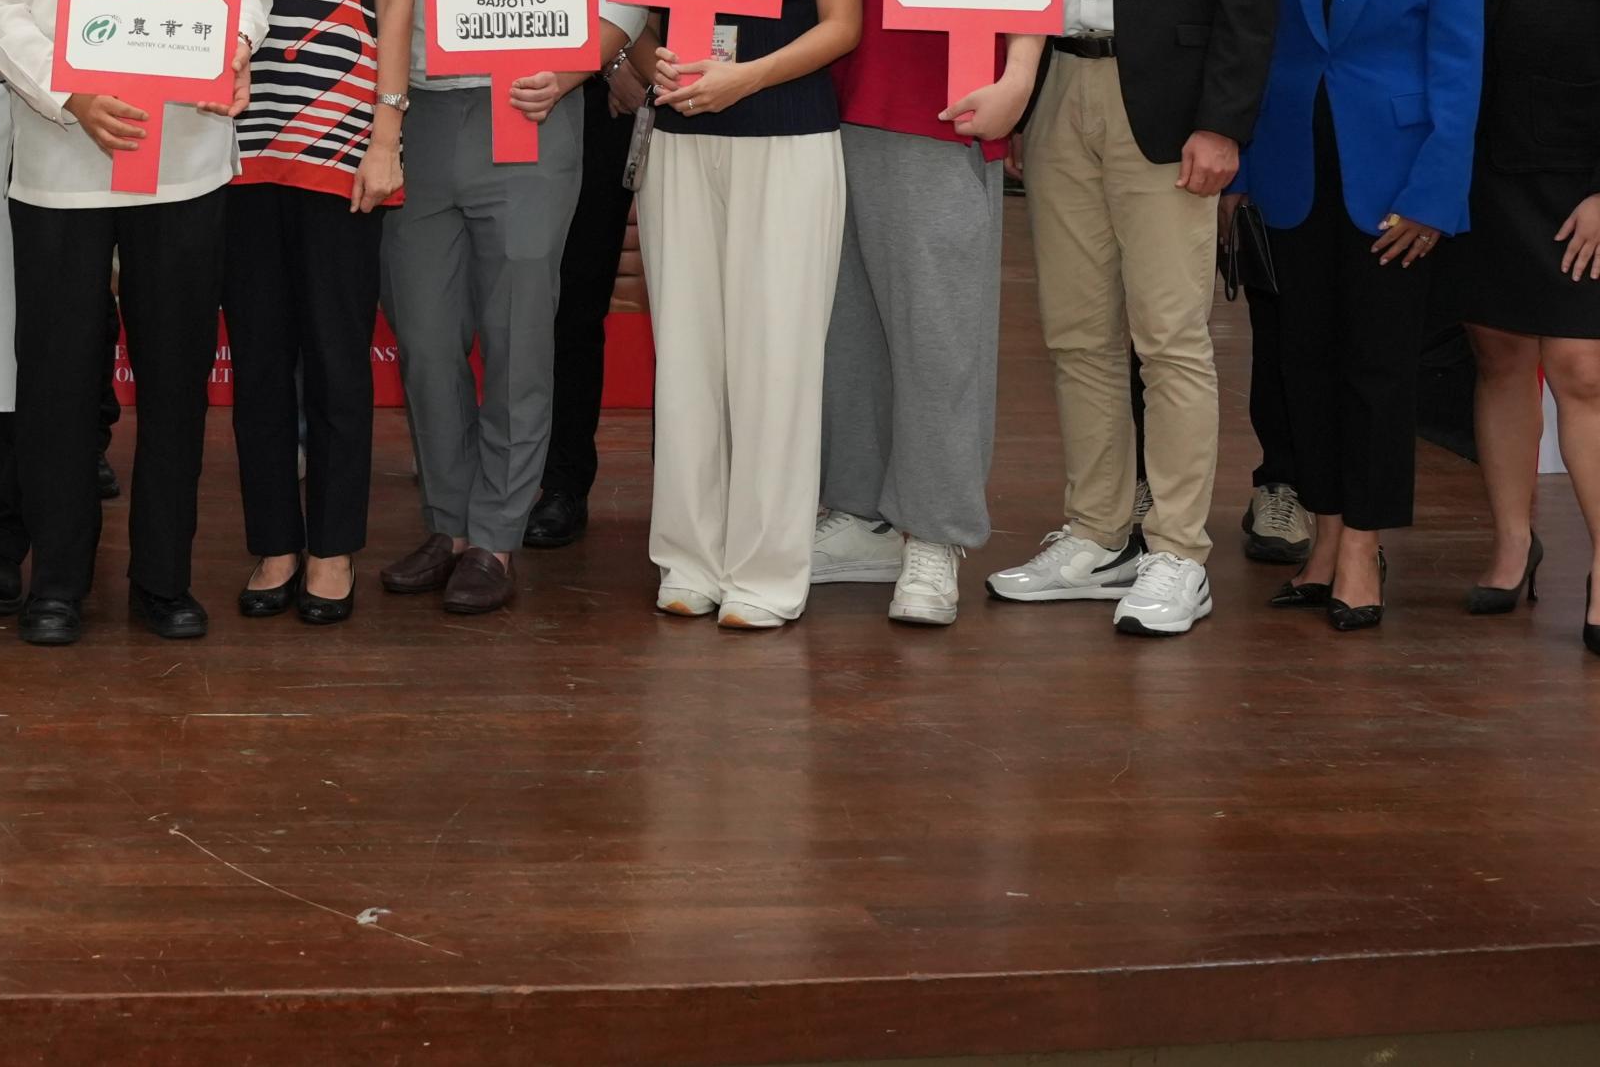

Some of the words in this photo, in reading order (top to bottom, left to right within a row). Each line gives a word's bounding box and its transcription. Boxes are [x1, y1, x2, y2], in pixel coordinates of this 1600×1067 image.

[128, 18, 212, 40] 農業部
[456, 10, 569, 40] SALUMERIA
[126, 40, 156, 49] MINISTRY
[168, 44, 211, 53] AGRICULTURE
